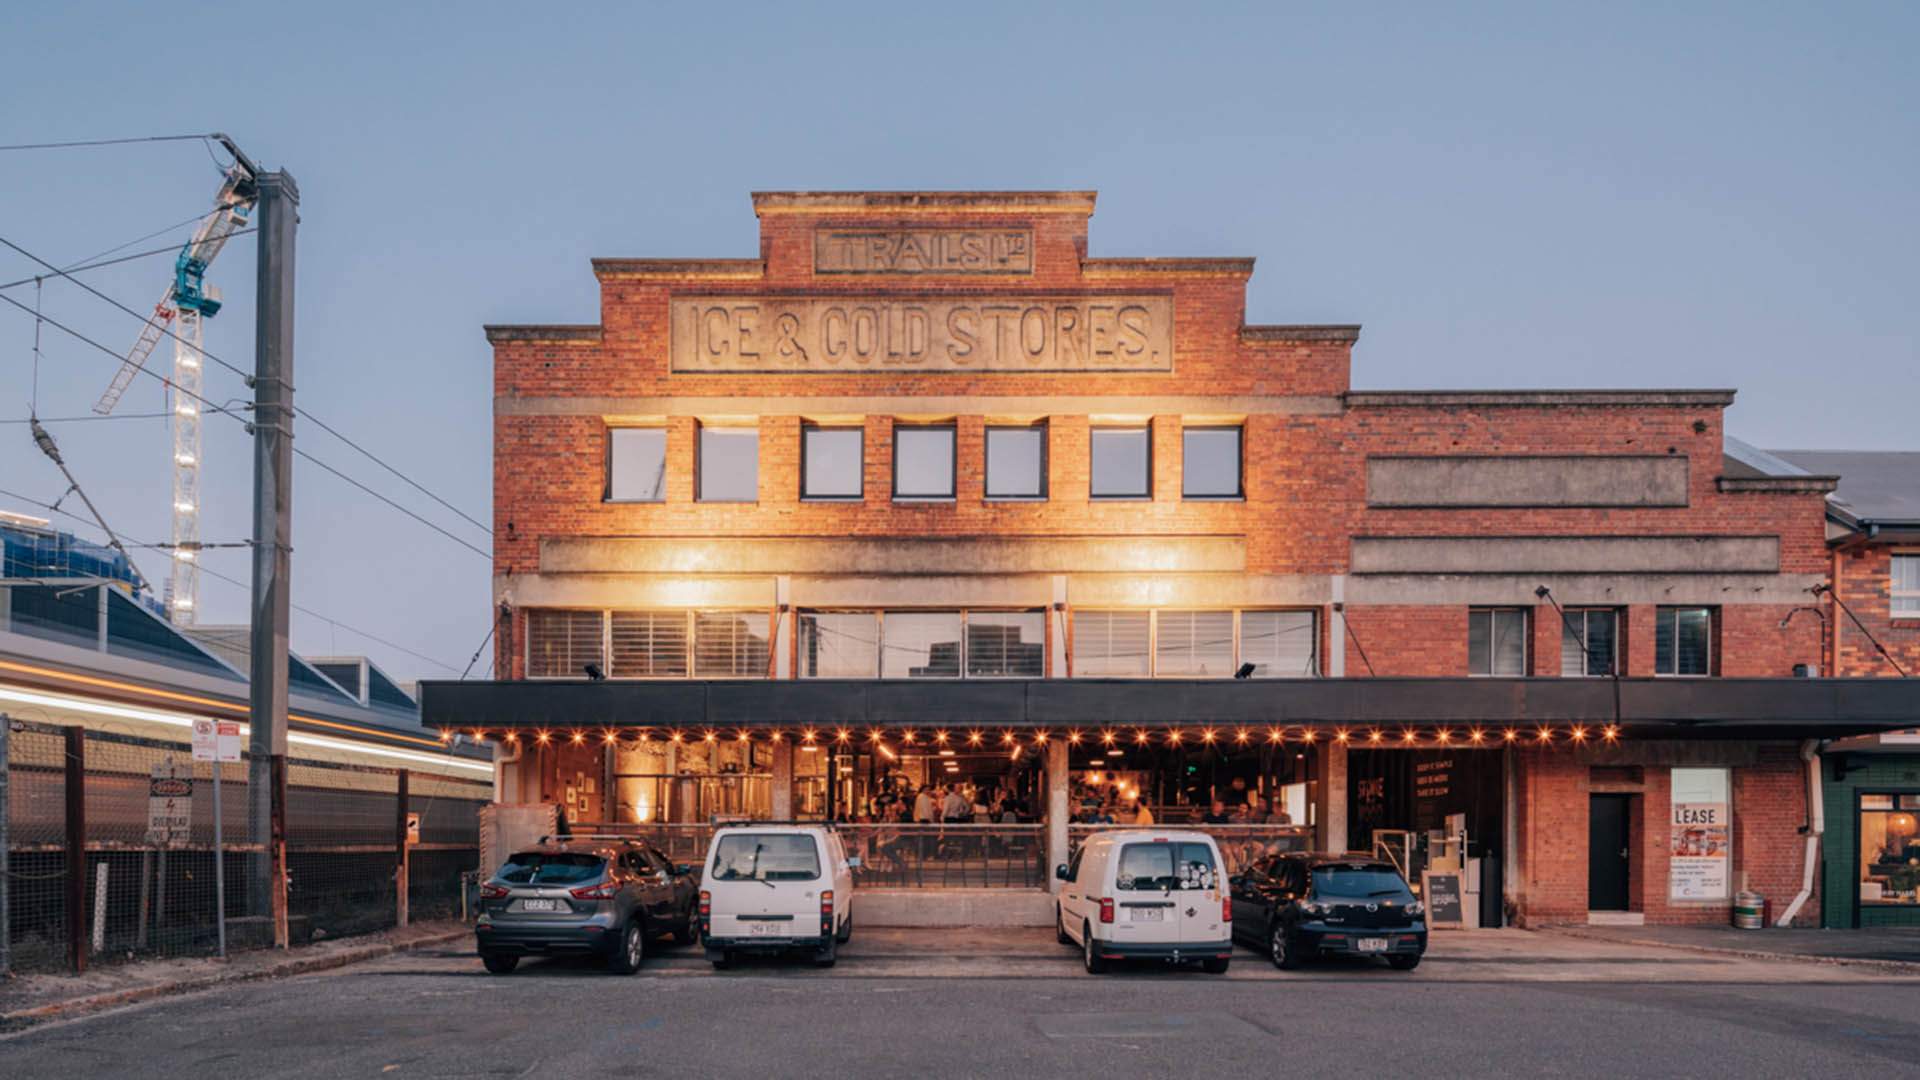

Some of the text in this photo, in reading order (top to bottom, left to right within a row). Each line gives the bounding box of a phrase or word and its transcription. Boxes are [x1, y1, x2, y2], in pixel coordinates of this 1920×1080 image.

[830, 231, 986, 271] TRAILS
[691, 304, 761, 365] ICE
[774, 311, 810, 366] &
[819, 304, 933, 365] COLD
[1675, 808, 1716, 824] LEASE
